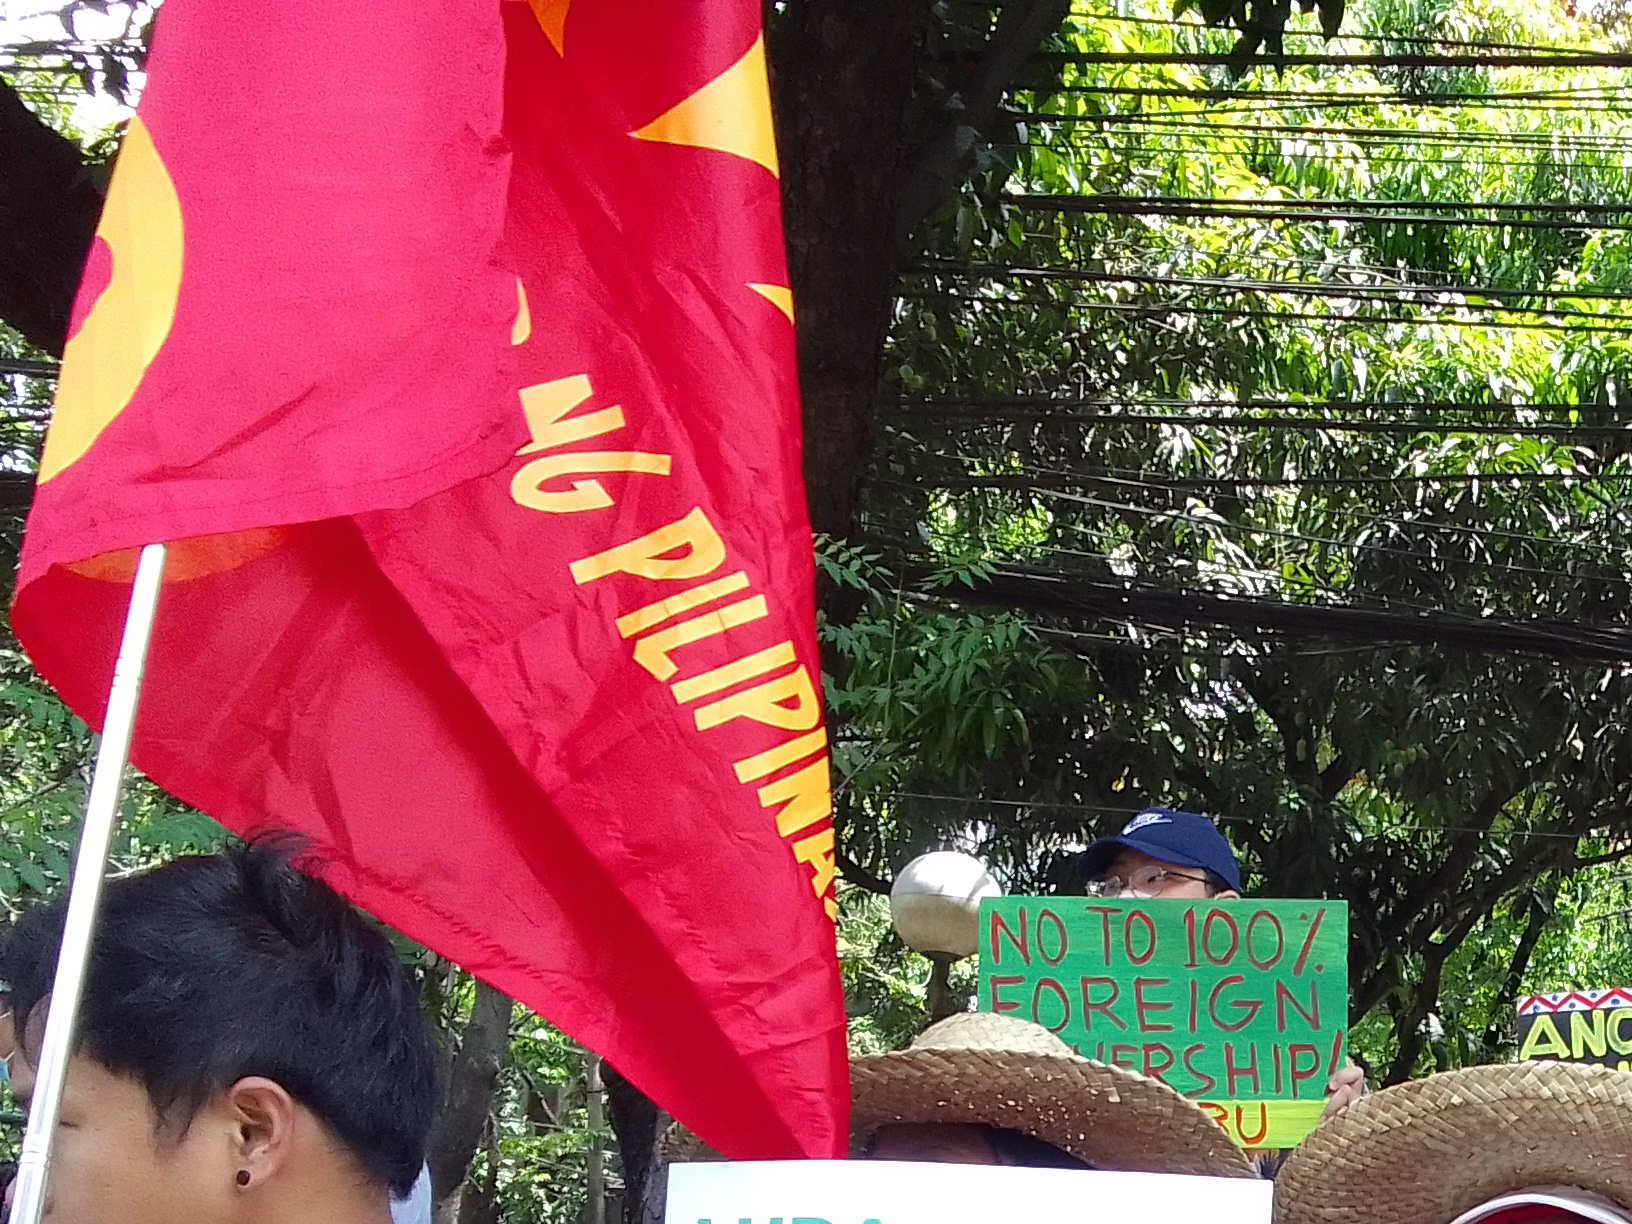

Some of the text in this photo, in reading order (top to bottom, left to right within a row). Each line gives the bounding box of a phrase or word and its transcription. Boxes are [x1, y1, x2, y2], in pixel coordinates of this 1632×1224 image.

[511, 374, 837, 923] NG PILIPINA
[989, 905, 1326, 977] NO TO 100%
[989, 974, 1321, 1036] FOREIGN
[1073, 1029, 1344, 1101] ERSHIP!
